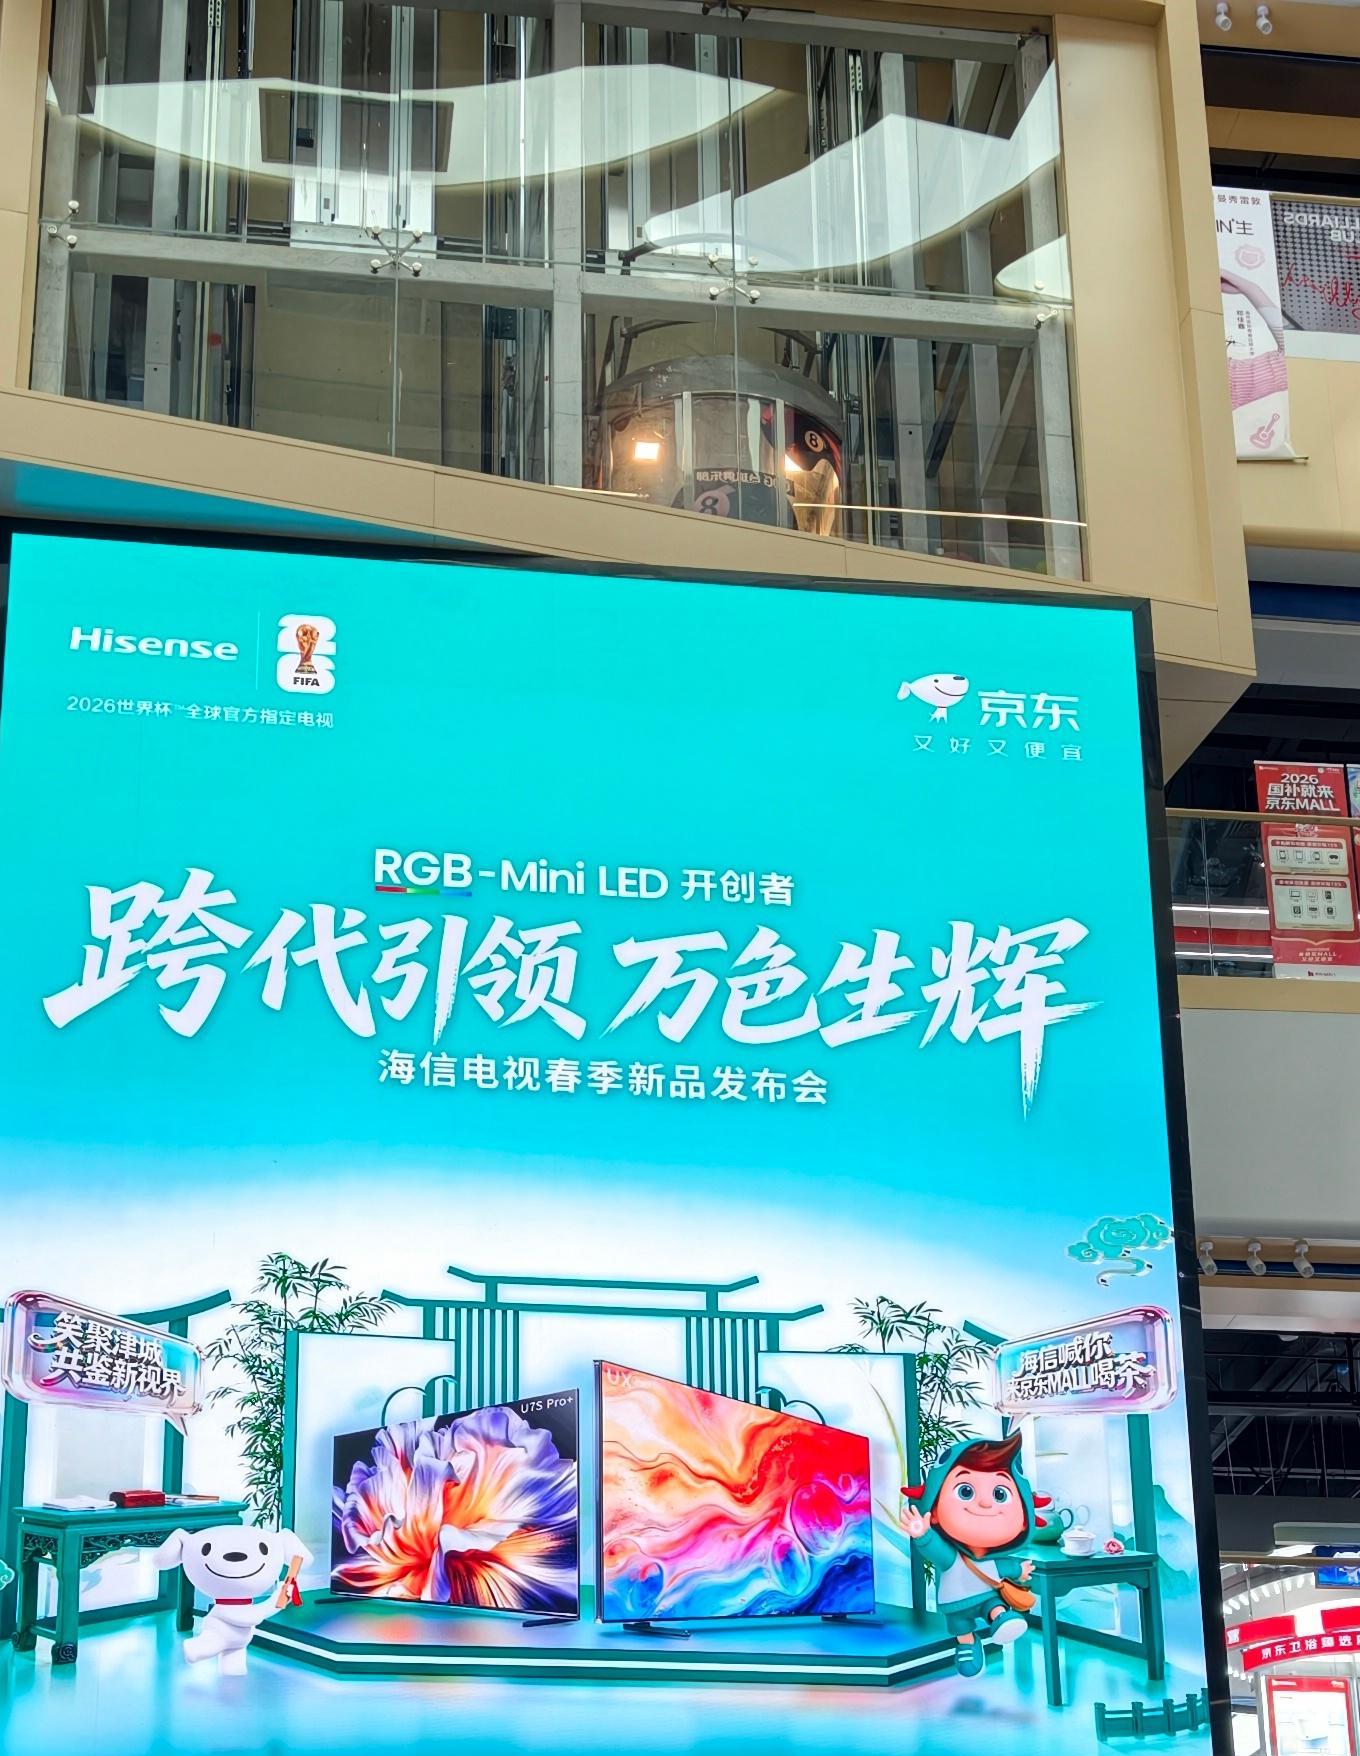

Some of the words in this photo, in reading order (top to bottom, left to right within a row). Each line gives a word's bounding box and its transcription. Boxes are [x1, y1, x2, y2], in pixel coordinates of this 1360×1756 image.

[68, 626, 240, 662] Hisense
[292, 675, 321, 688] FIFA
[977, 689, 1081, 732] 京东
[912, 734, 1085, 763] 又好又便宜
[1267, 783, 1335, 799] 国补就来
[1280, 773, 1320, 785] 2026
[1265, 797, 1341, 812] 京东MALL
[596, 862, 669, 899] LED
[679, 868, 796, 908] 开创者
[43, 868, 587, 1045] 跨代引领
[601, 916, 1103, 1120] 万色生辉
[376, 1046, 831, 1106] 海信电视春季新品发布会
[520, 1400, 544, 1414] U7S
[546, 1395, 574, 1409] Pro+
